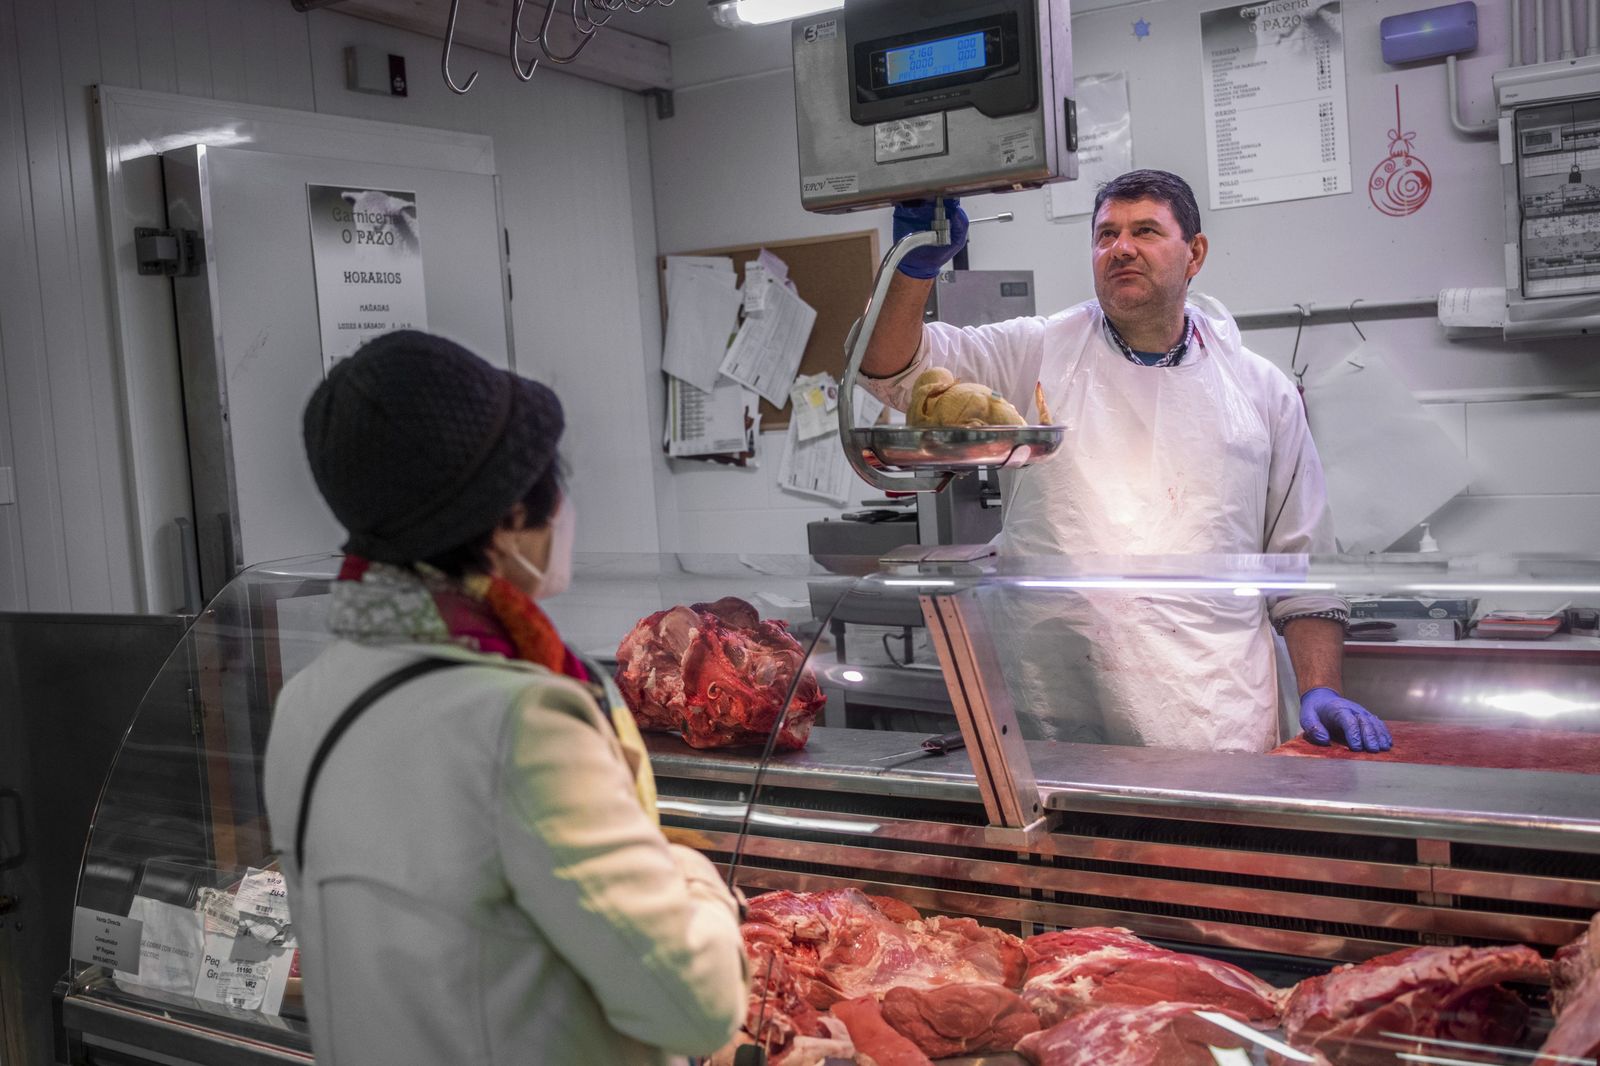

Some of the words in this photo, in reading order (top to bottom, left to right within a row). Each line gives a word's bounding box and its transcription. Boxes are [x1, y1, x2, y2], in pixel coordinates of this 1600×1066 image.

[1263, 15, 1302, 31] PAZO
[342, 229, 352, 244] O
[356, 230, 394, 245] PAZO
[344, 272, 402, 284] HORARIOS
